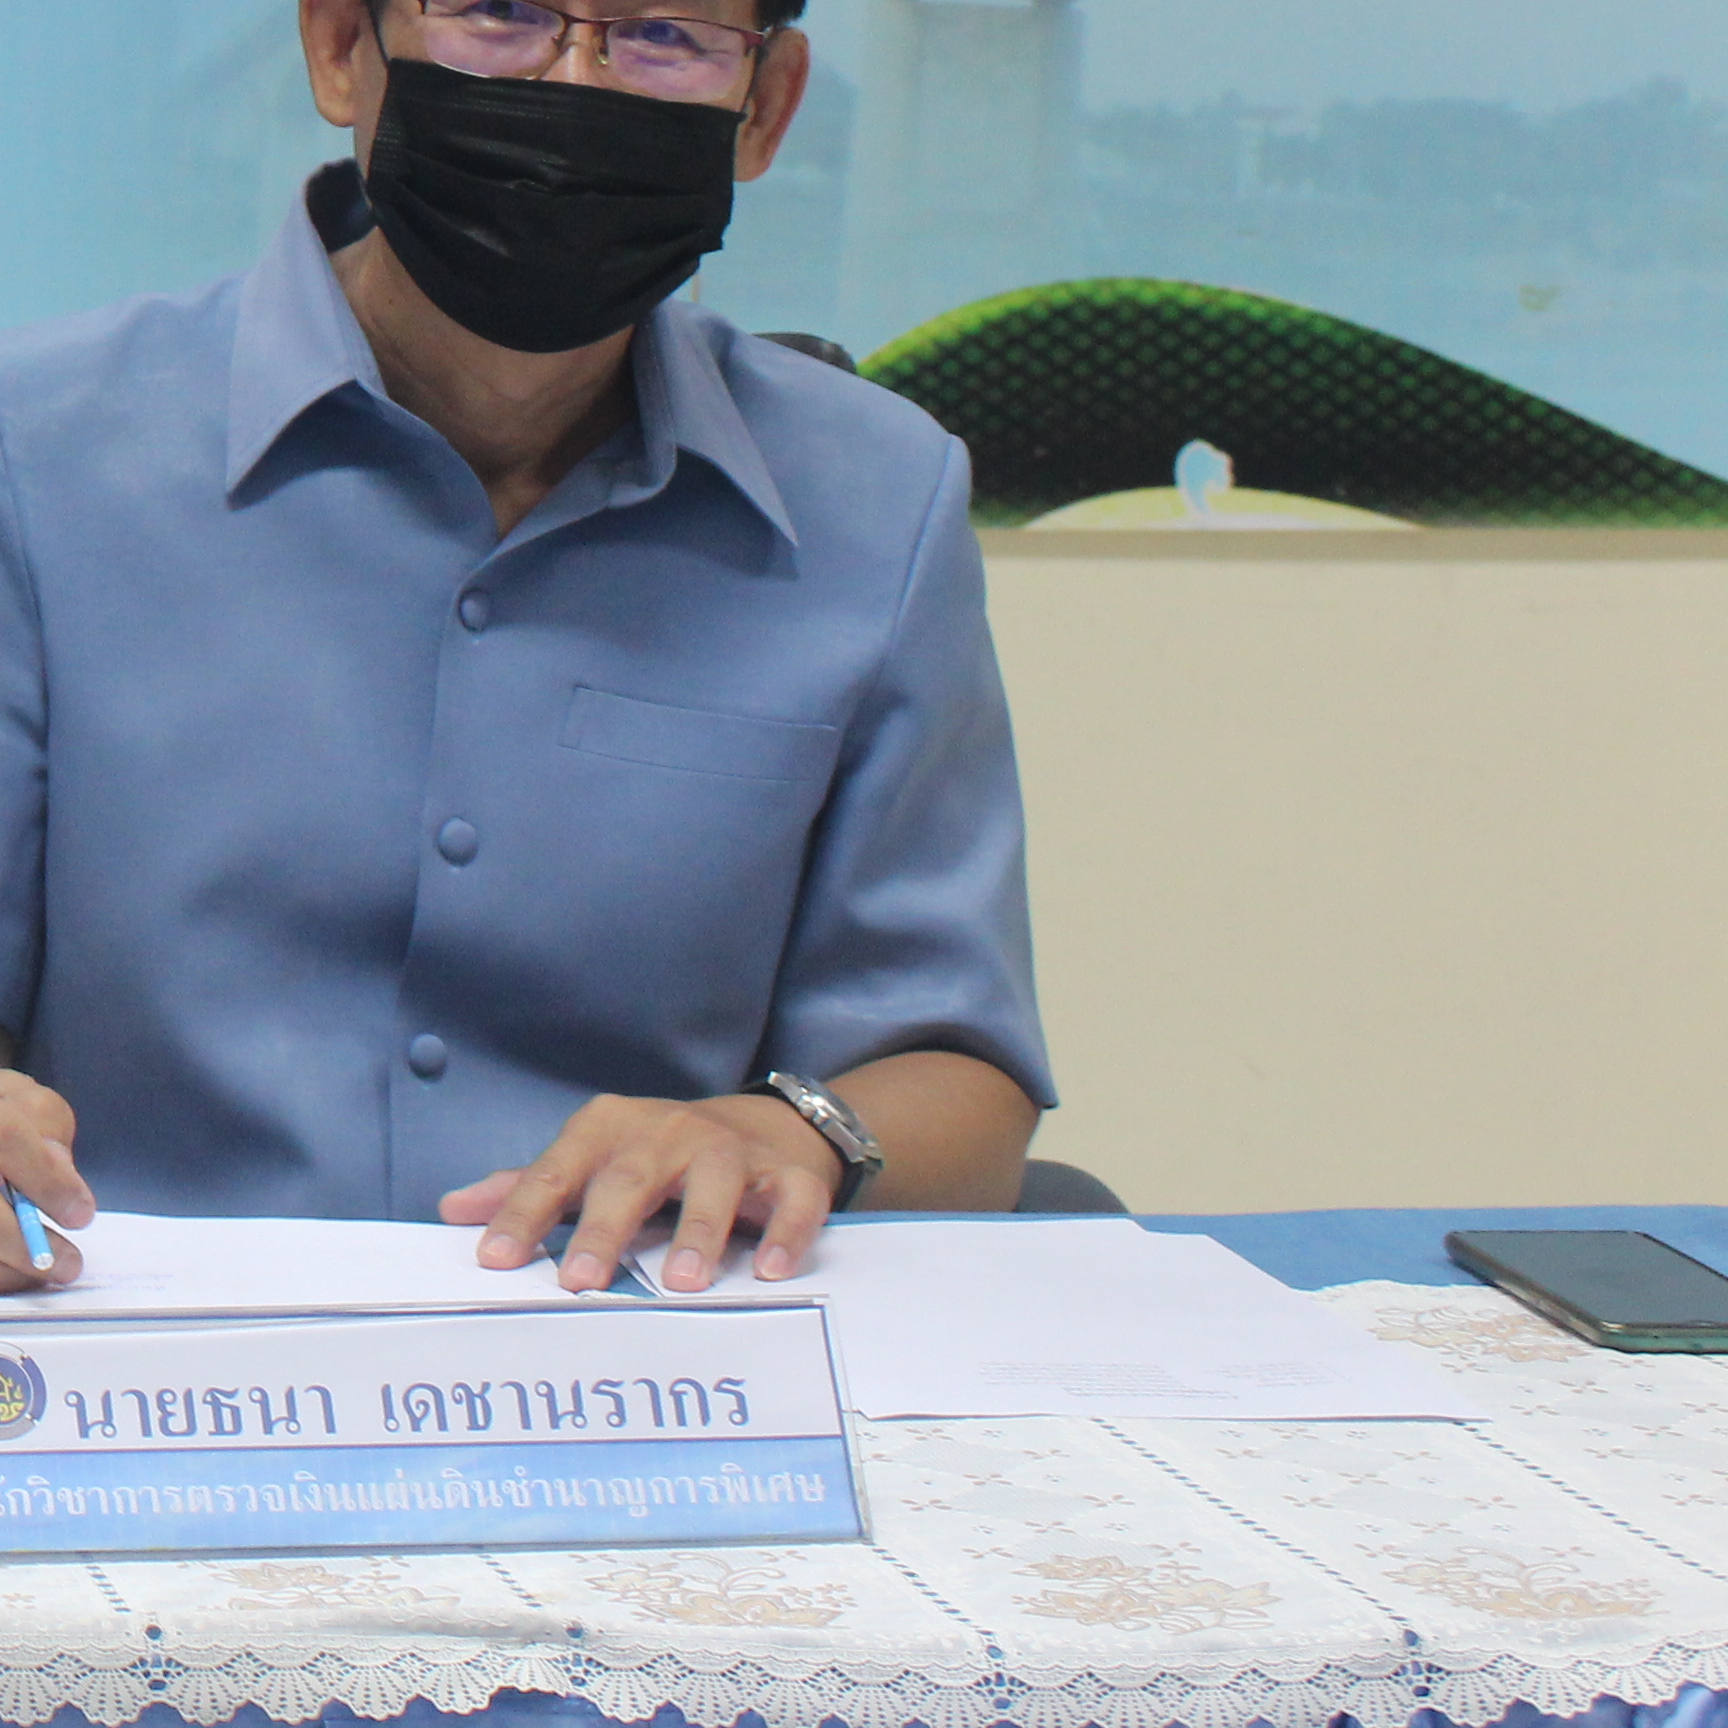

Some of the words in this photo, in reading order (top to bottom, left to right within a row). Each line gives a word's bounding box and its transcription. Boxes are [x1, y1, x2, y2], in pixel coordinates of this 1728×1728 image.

[64, 1383, 338, 1440] นายธนา
[380, 1375, 750, 1434] เดชานรากร
